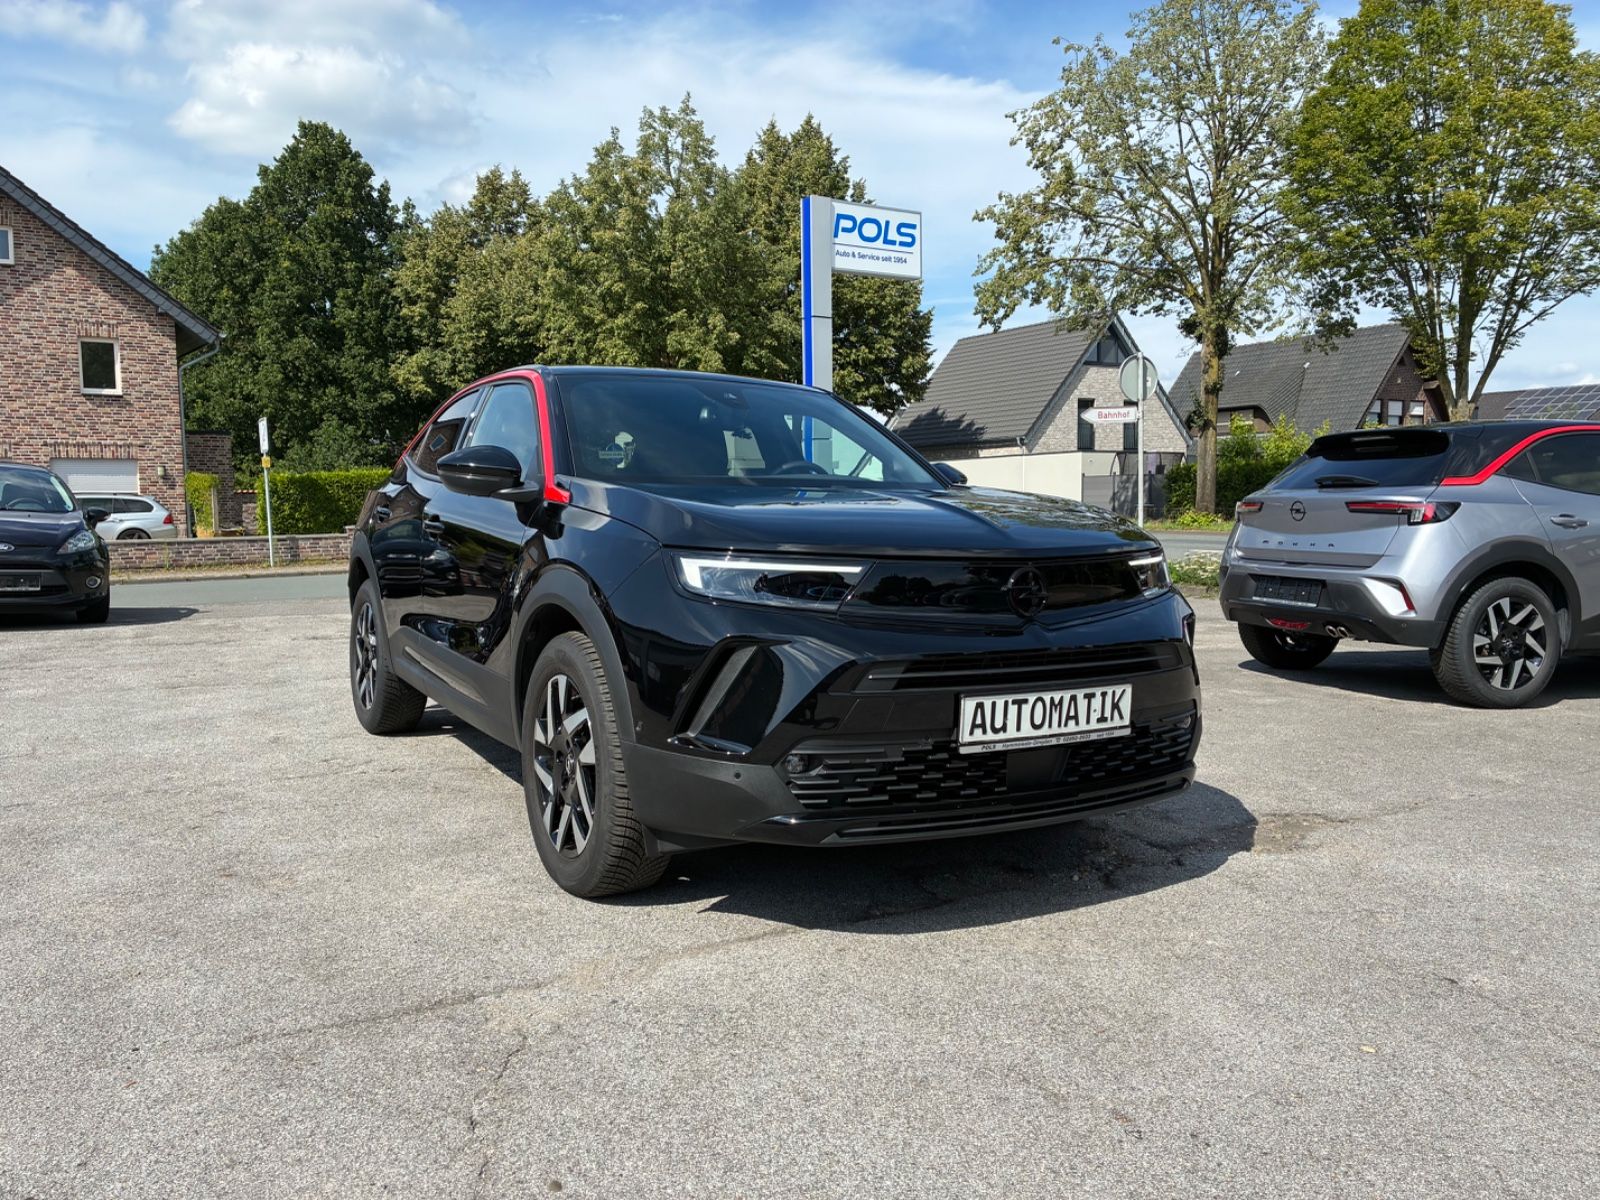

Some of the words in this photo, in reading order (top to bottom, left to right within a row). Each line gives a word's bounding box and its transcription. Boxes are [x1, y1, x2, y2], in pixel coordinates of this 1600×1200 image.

[833, 213, 917, 248] POLS
[836, 250, 850, 258] Auto
[858, 252, 880, 261] Service
[881, 255, 892, 263] seit
[893, 256, 908, 264] 1954
[1097, 410, 1130, 419] Bahnhof
[969, 688, 1127, 736] AUTOMATIK
